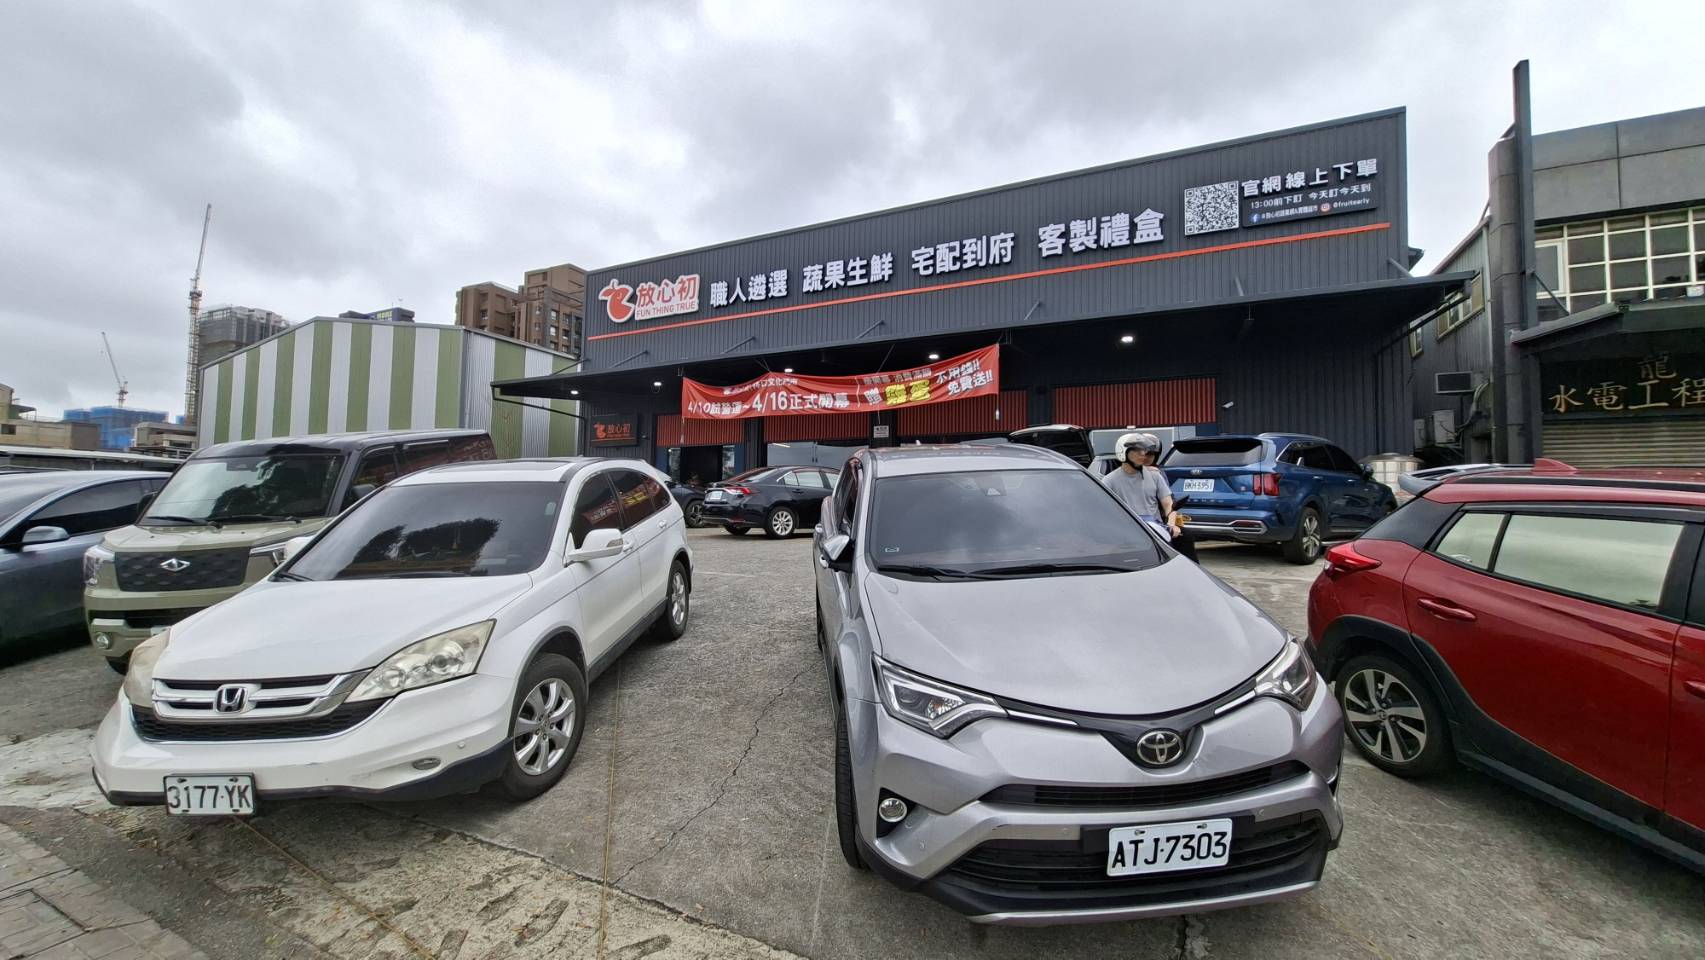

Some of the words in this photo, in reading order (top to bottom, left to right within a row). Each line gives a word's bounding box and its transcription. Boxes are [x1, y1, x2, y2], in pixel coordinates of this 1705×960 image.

[1241, 159, 1377, 197] 官網線上下單
[710, 269, 788, 307] 職人遴選
[802, 252, 893, 293] 蔬果生鮮
[911, 232, 1015, 276] 宅配到府
[1038, 208, 1164, 257] 客製禮盒
[636, 276, 697, 308] 放心初
[636, 309, 651, 318] FUN
[652, 305, 675, 315] THING
[675, 302, 696, 312] TRUE
[1637, 352, 1676, 379] 龍
[1549, 378, 1705, 413] 水電工程
